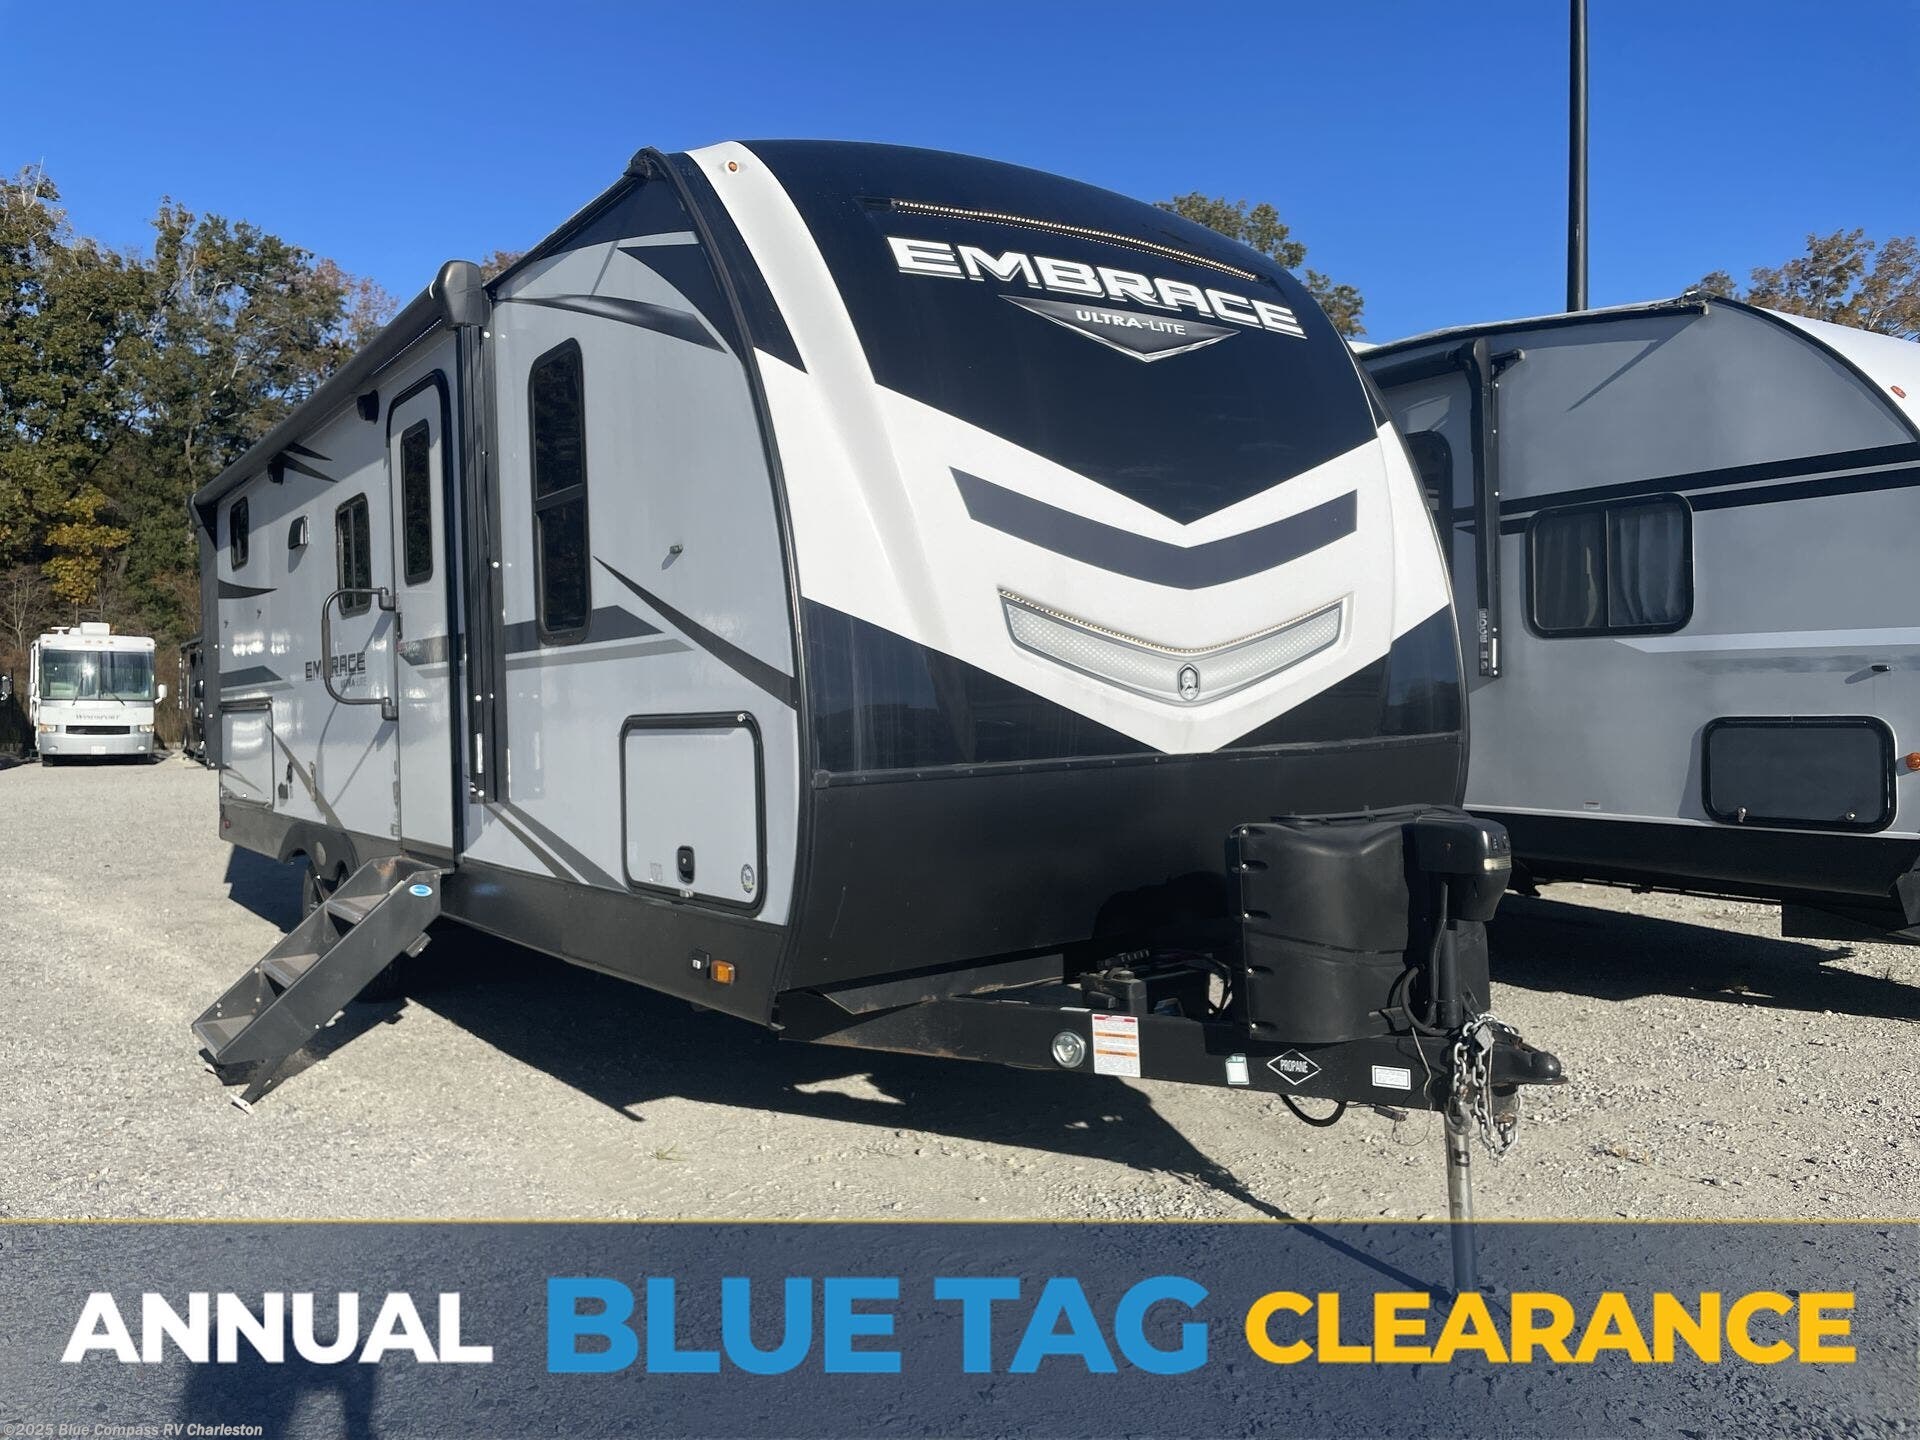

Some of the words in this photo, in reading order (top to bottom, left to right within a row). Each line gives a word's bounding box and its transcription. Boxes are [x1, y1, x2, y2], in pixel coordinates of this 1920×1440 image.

[887, 235, 1308, 340] EMBRACE
[1076, 309, 1187, 337] ULTRA-LITE
[305, 651, 366, 682] EMRACE
[1279, 1059, 1309, 1074] PROPANE
